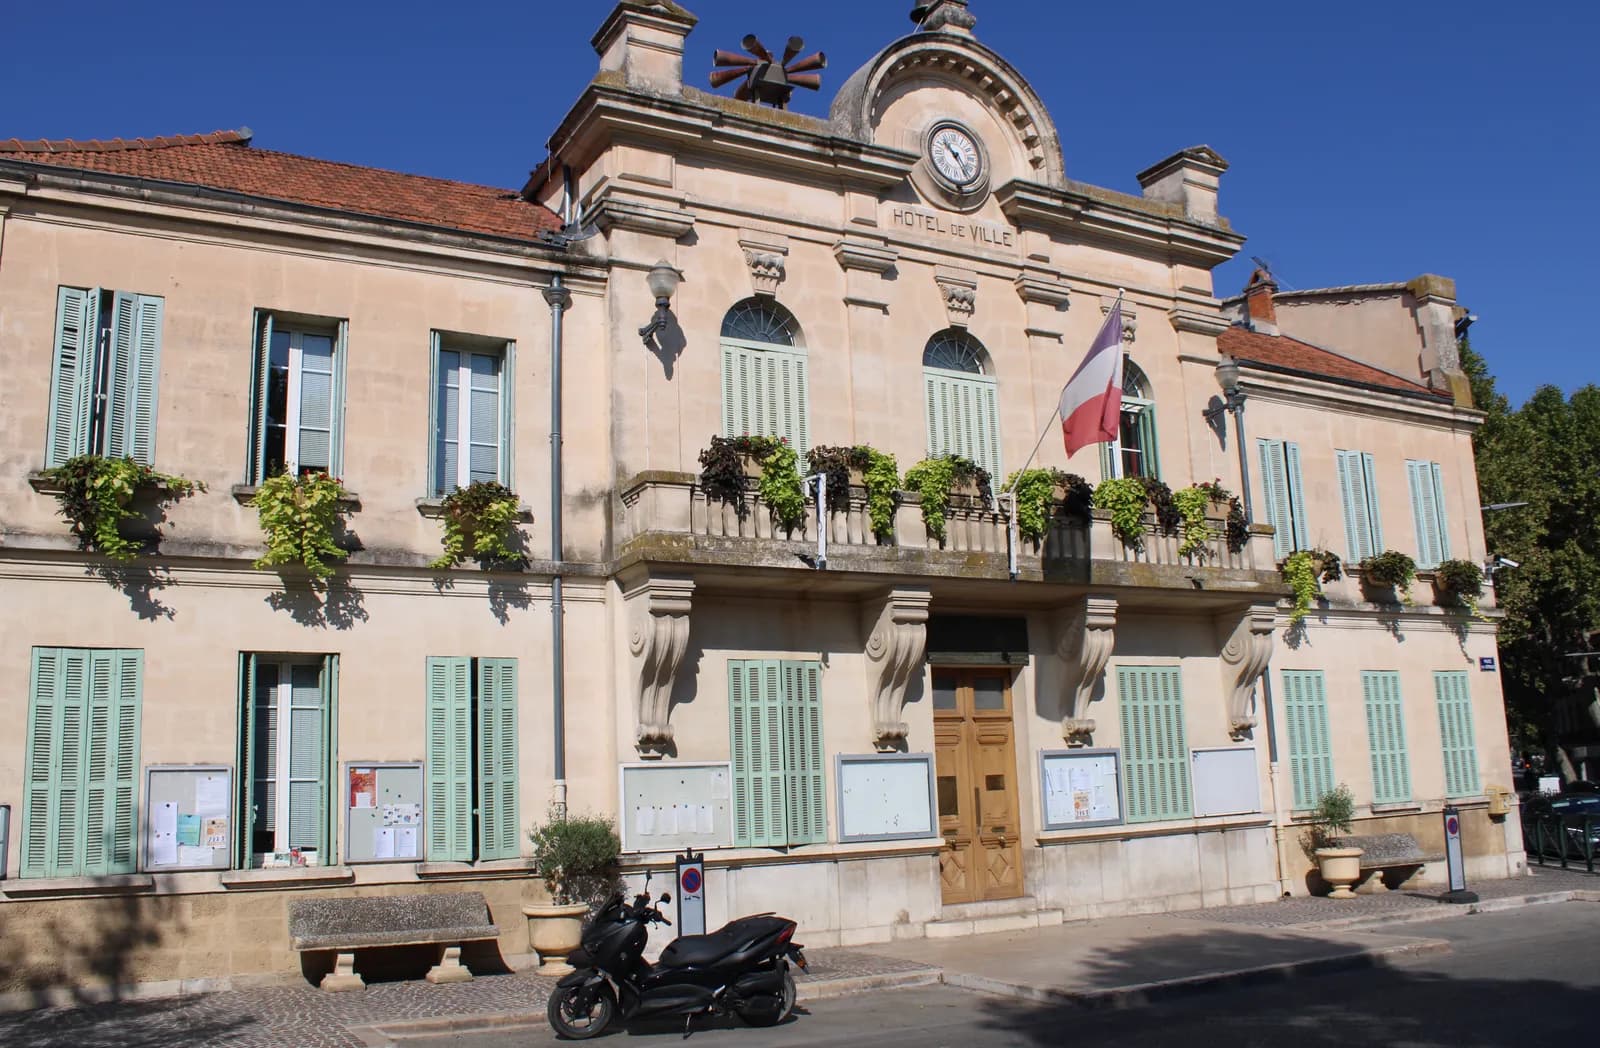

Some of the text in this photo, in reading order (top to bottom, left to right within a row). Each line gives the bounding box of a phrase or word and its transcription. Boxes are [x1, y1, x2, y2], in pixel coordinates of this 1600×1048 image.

[893, 208, 1012, 247] HOTEL DE VILLE
